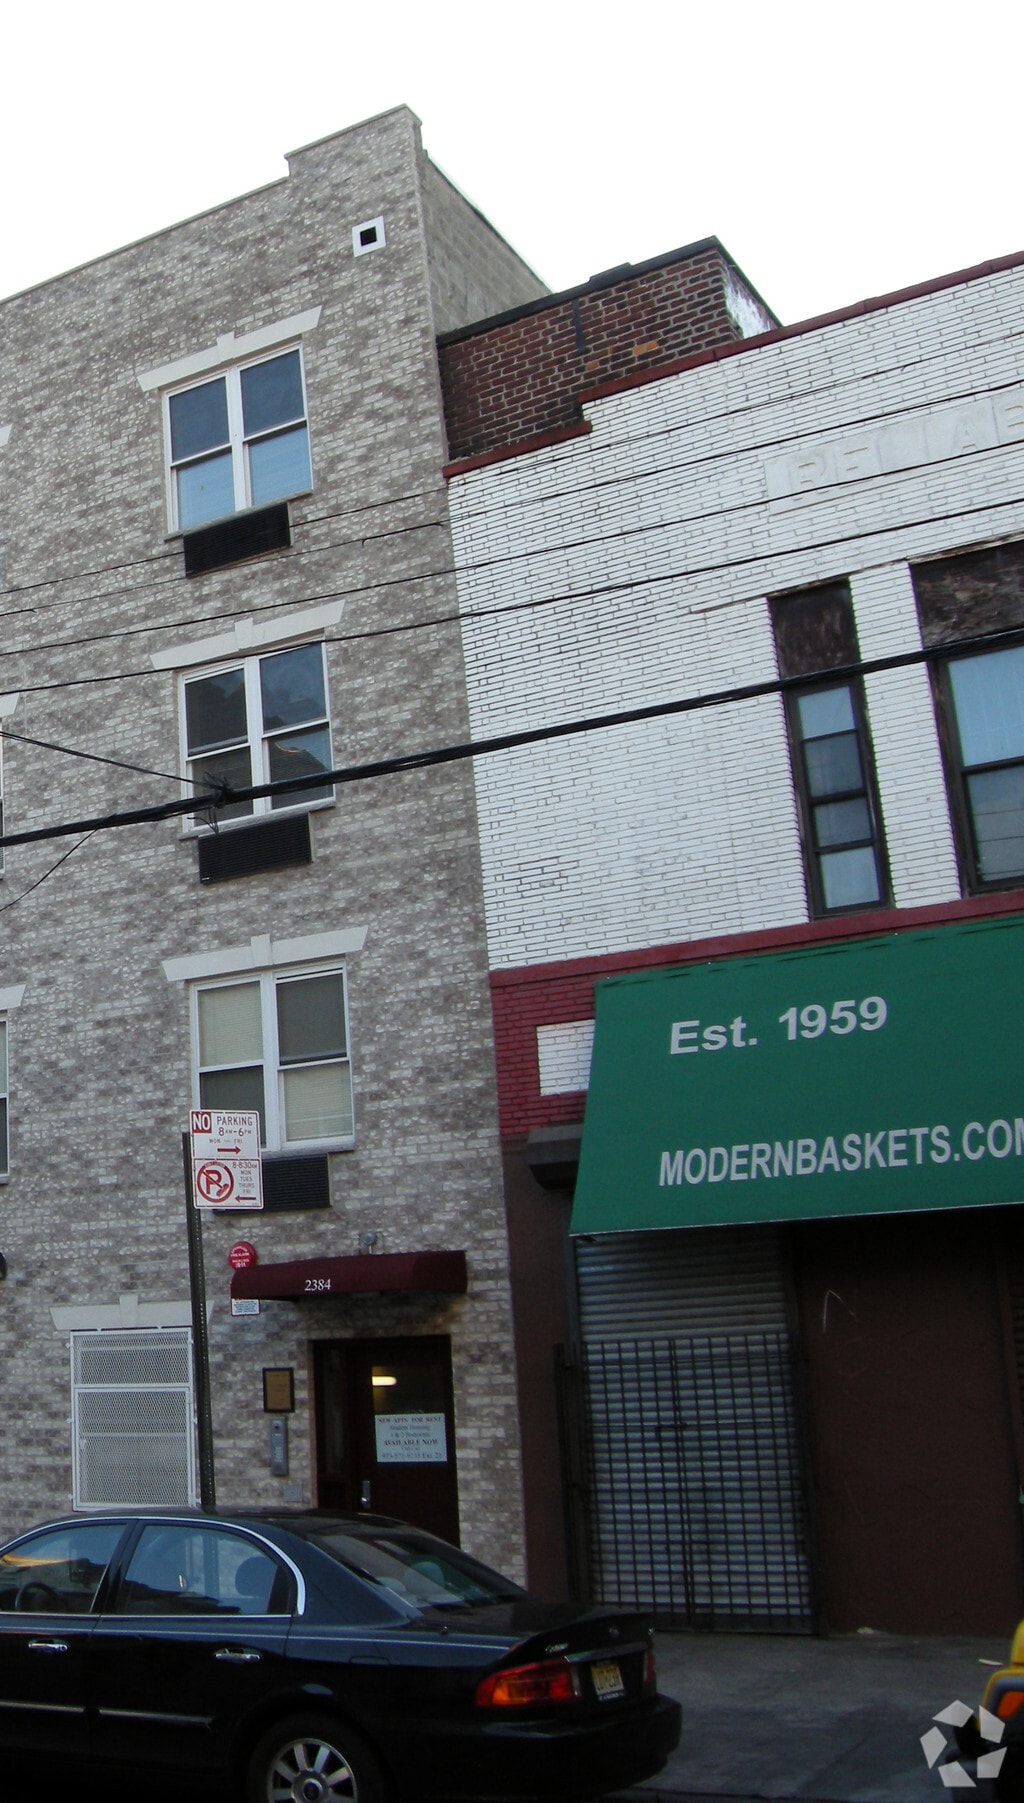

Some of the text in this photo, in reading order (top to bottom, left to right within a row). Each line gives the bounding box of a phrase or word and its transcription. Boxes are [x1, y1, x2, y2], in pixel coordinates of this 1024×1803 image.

[670, 996, 888, 1055] Est. 1959
[192, 1113, 253, 1131] NO PARKING
[304, 1278, 332, 1291] 2384
